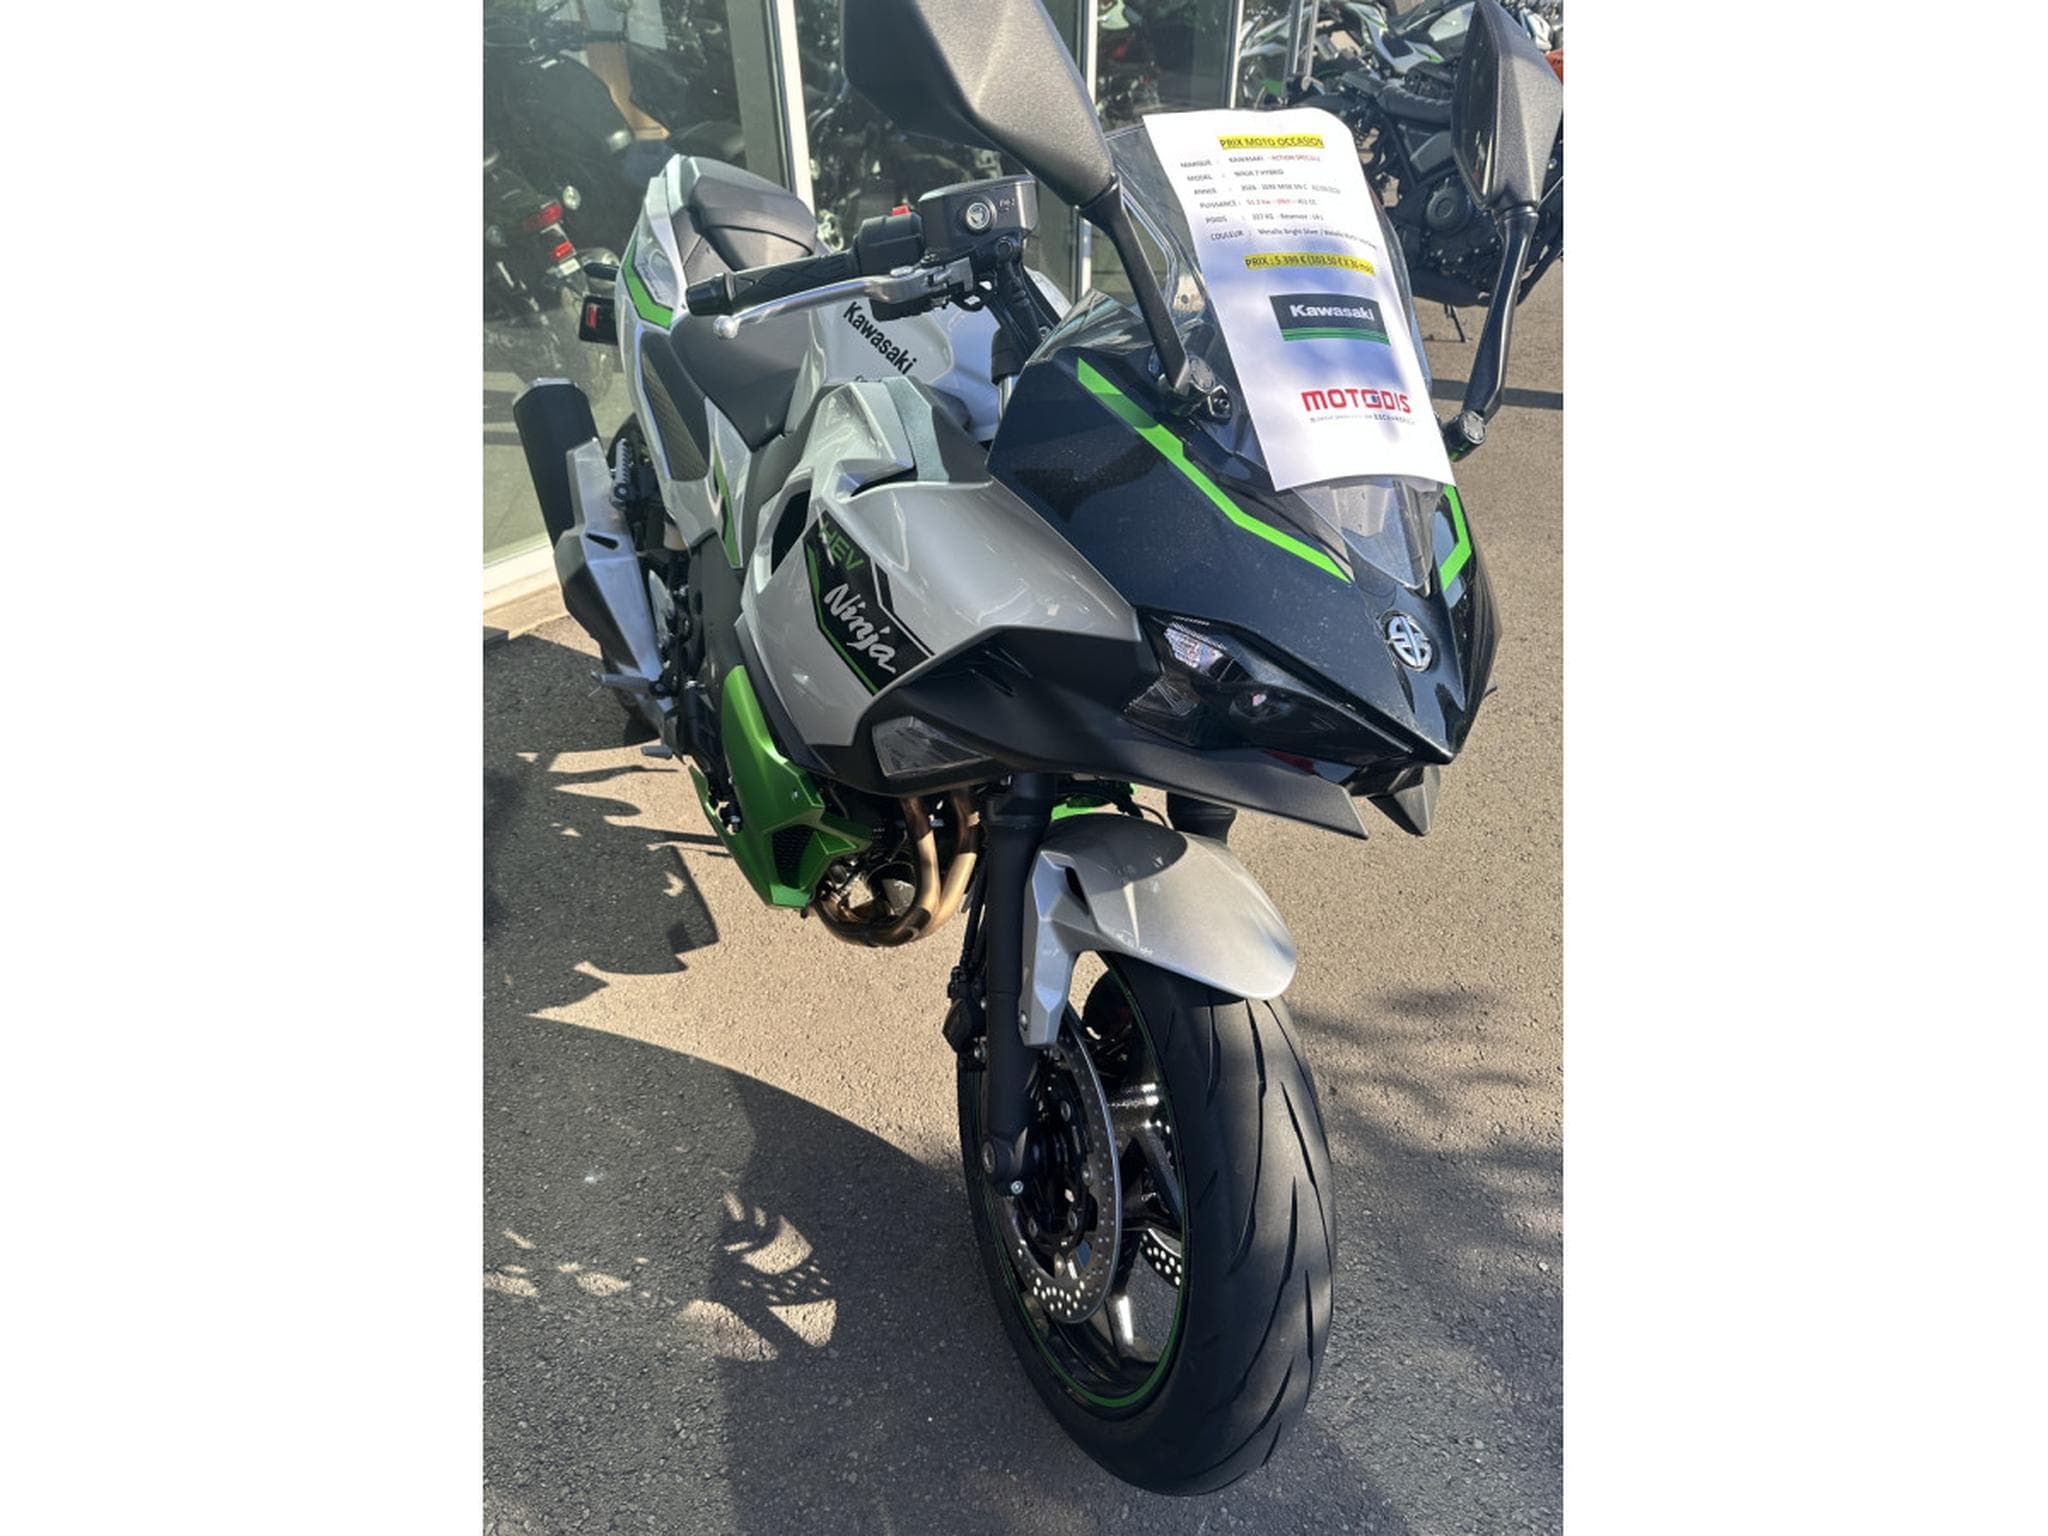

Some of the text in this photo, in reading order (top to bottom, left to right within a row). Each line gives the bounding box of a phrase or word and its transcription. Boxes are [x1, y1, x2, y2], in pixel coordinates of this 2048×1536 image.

[1219, 136, 1325, 147] PRIX MOTO OCCASION
[1210, 229, 1244, 240] COULEUR
[1245, 256, 1271, 267] PRIX
[1290, 304, 1374, 321] Kawasaki
[843, 301, 917, 375] Kawasaki
[818, 521, 865, 571] HEV
[824, 583, 896, 674] Ninja
